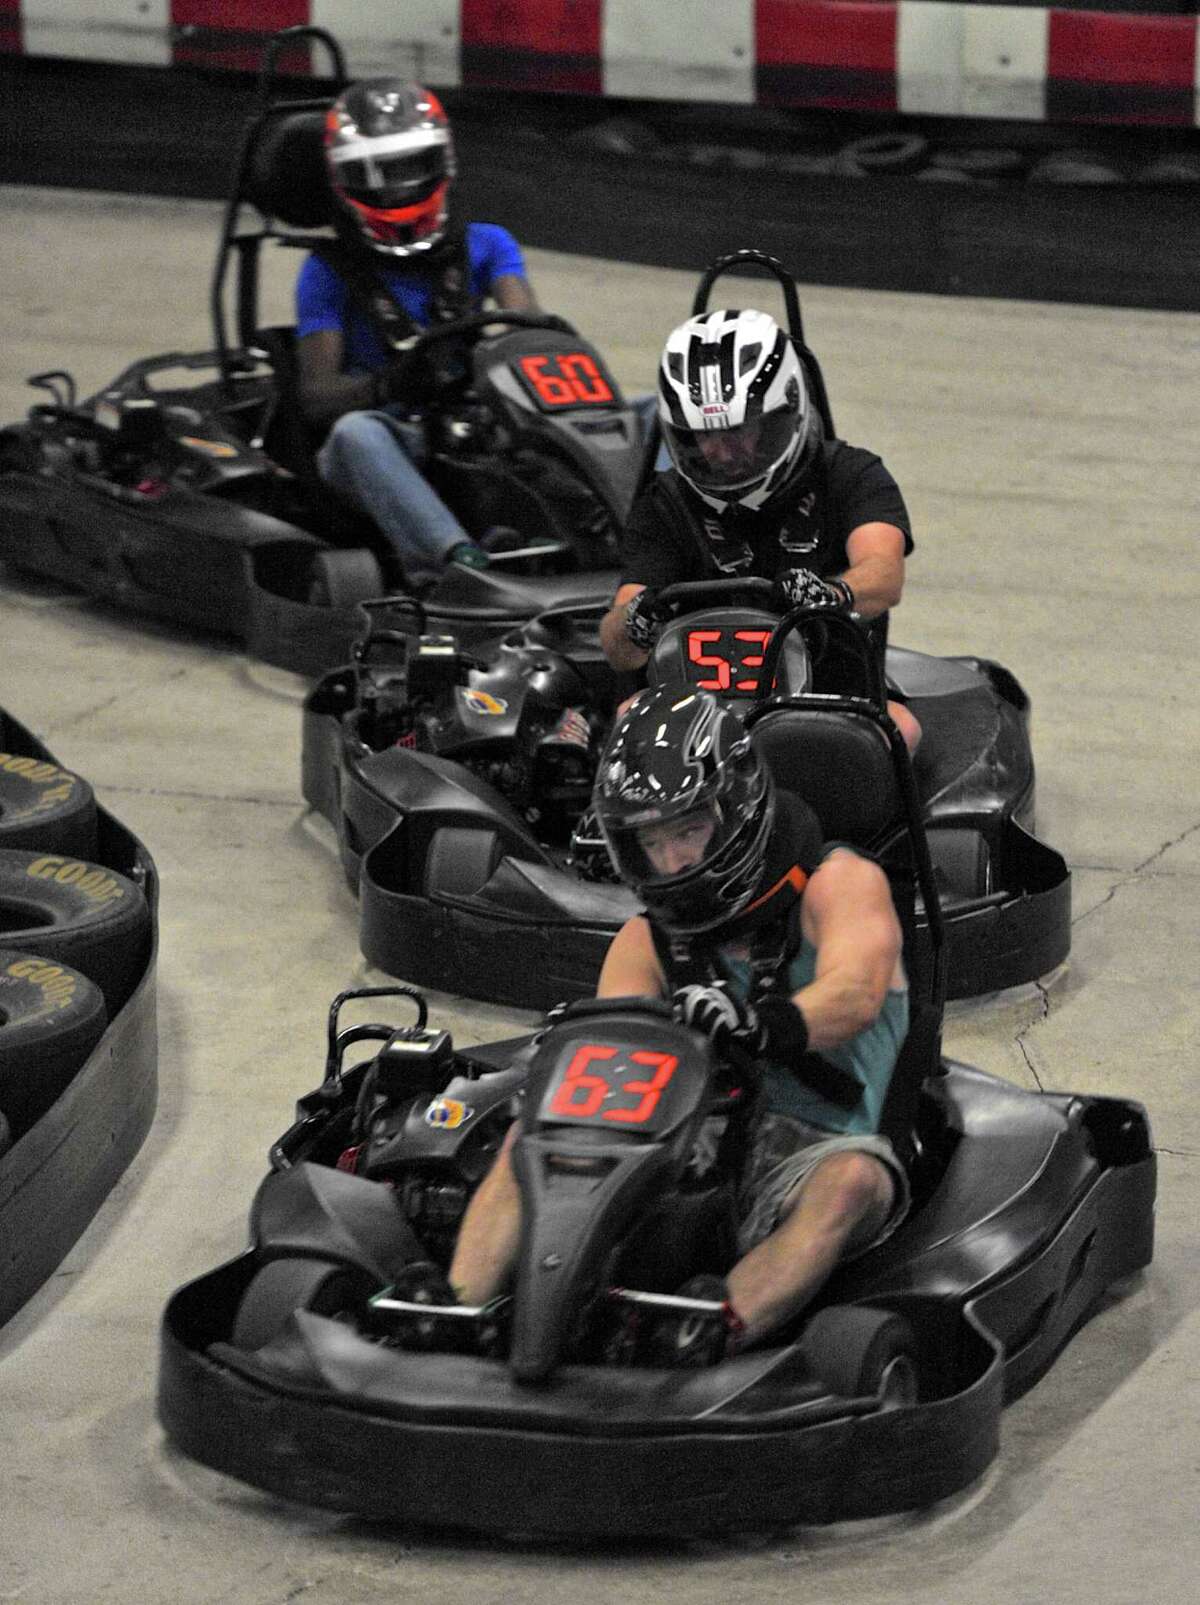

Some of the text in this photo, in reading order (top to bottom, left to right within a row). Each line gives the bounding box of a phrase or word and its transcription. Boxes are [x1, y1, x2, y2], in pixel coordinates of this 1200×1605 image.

[521, 353, 614, 405] 60
[688, 630, 776, 690] 53
[549, 1045, 679, 1123] 63
